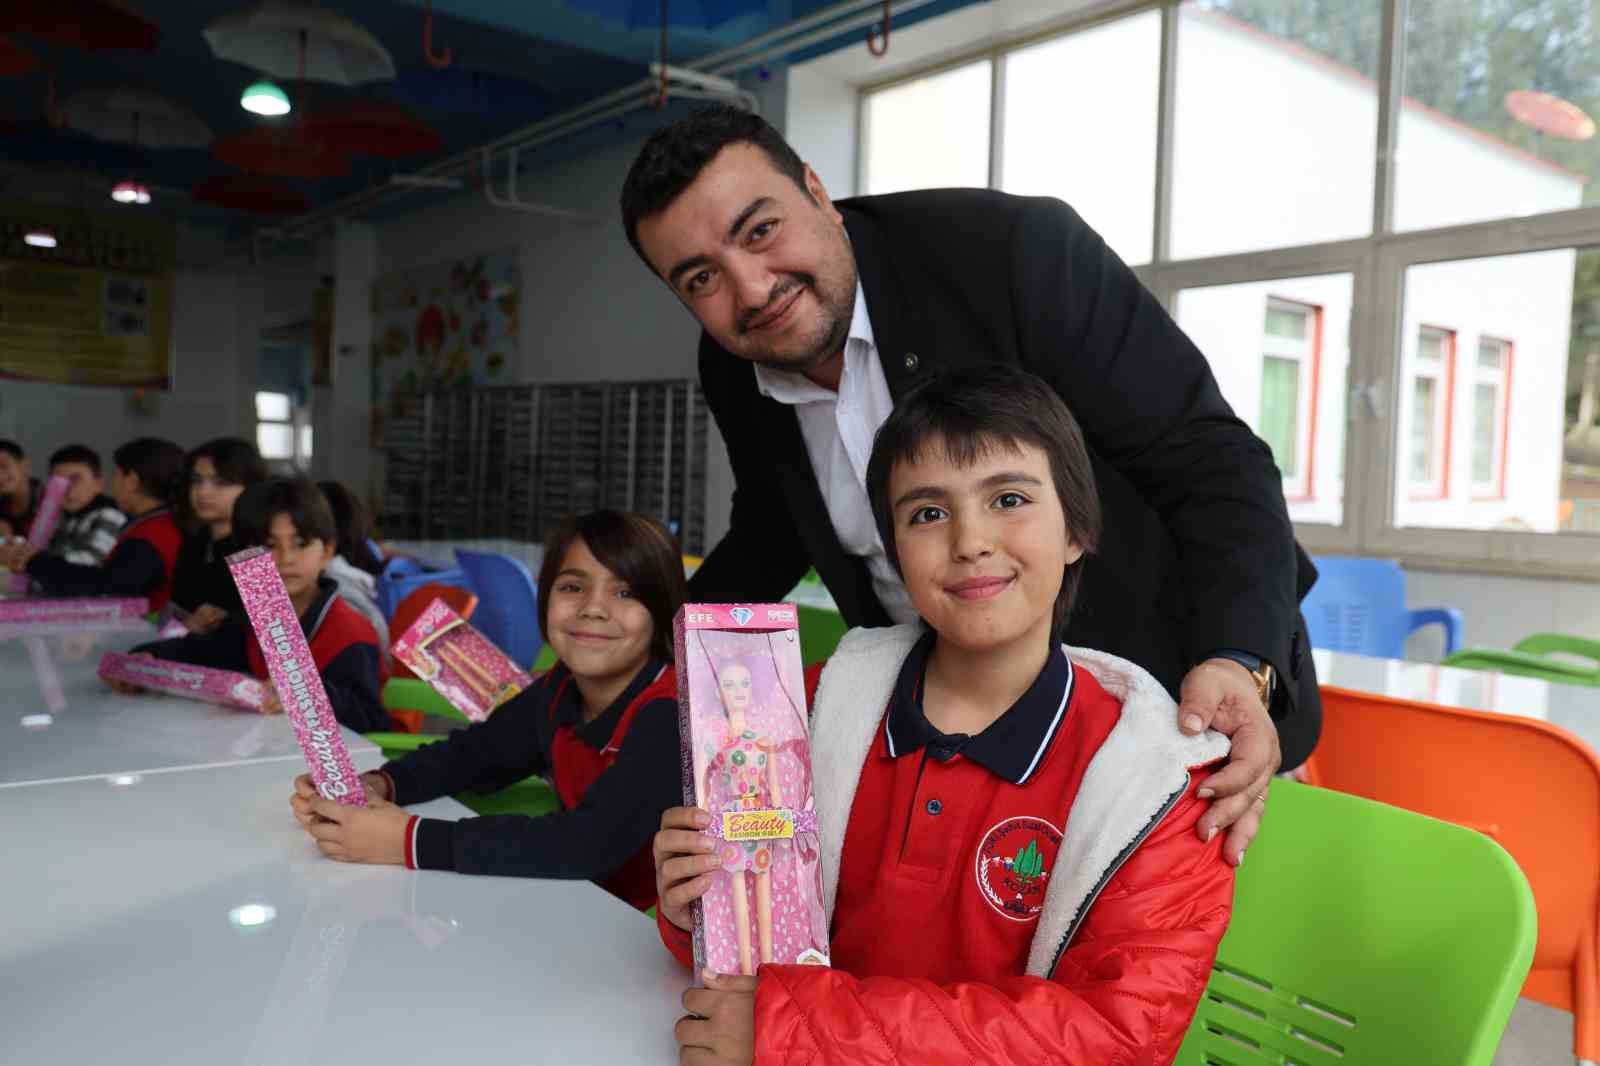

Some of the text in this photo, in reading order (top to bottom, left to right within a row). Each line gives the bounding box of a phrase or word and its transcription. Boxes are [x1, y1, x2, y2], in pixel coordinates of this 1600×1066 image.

[688, 612, 713, 624] EFE
[269, 617, 348, 800] Beauty FASHION GIRL
[729, 814, 785, 833] Beauty
